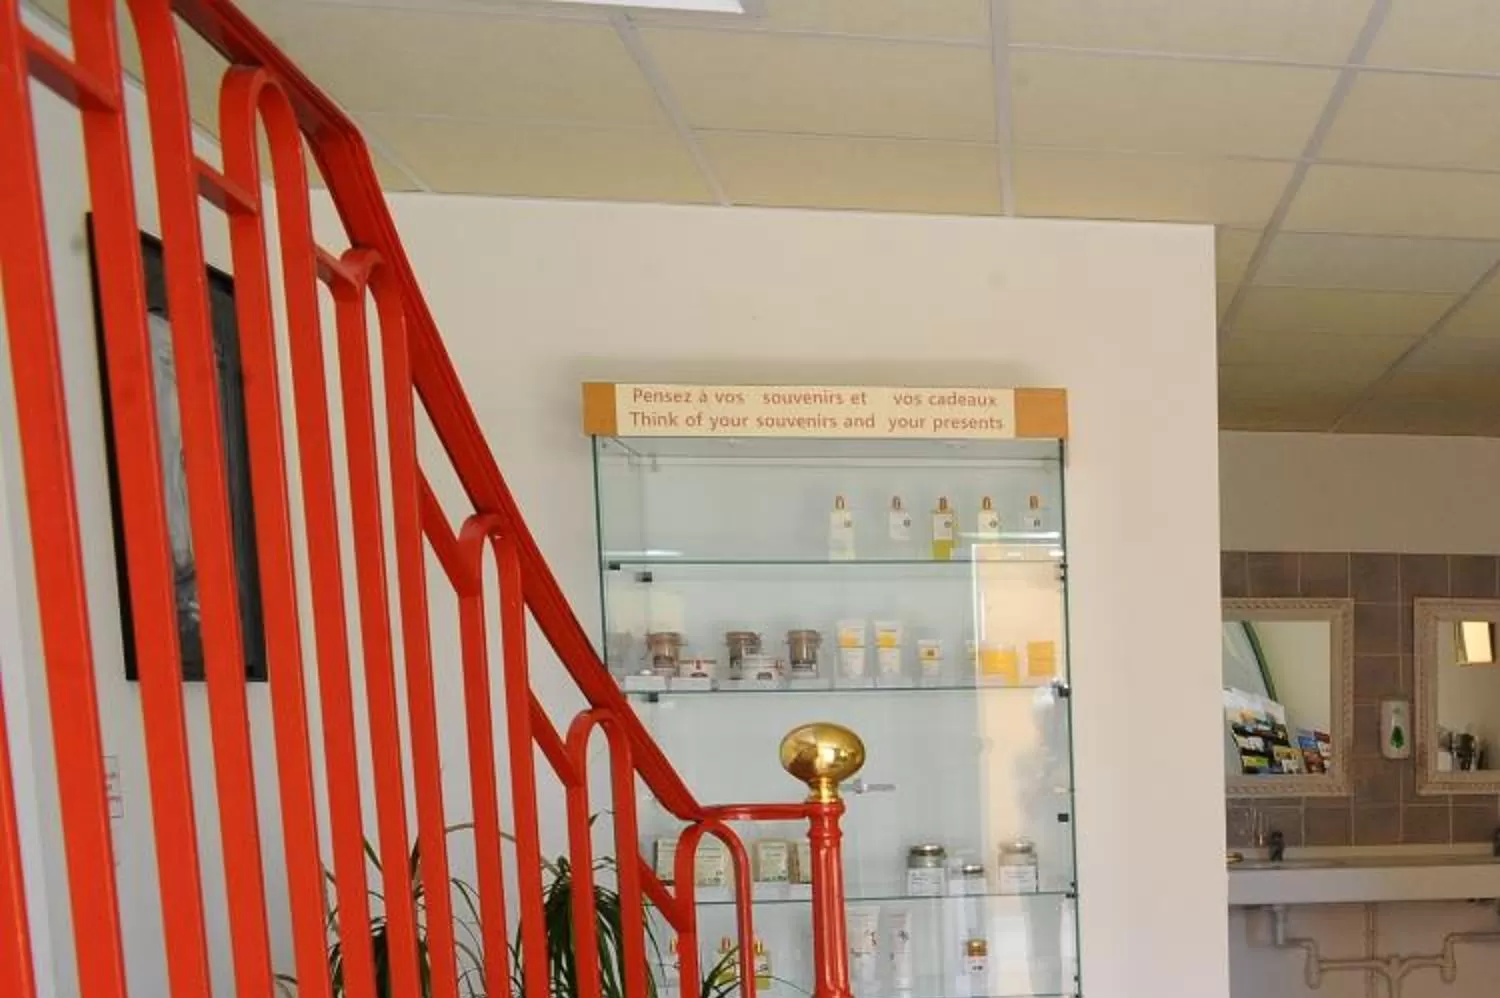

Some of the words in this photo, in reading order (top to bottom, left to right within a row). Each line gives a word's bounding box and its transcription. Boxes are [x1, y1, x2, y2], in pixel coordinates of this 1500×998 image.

[633, 387, 692, 404] Pensez
[715, 391, 745, 405] vos
[763, 389, 844, 405] souvenirs
[851, 392, 867, 406] et
[893, 393, 922, 406] vos
[928, 392, 998, 407] cadeaux
[630, 411, 679, 427] Think
[685, 412, 704, 427] of
[709, 415, 749, 431] your
[756, 414, 837, 429] souvenirs
[843, 413, 875, 429] and
[888, 417, 925, 432] your
[932, 417, 1003, 432] presents
